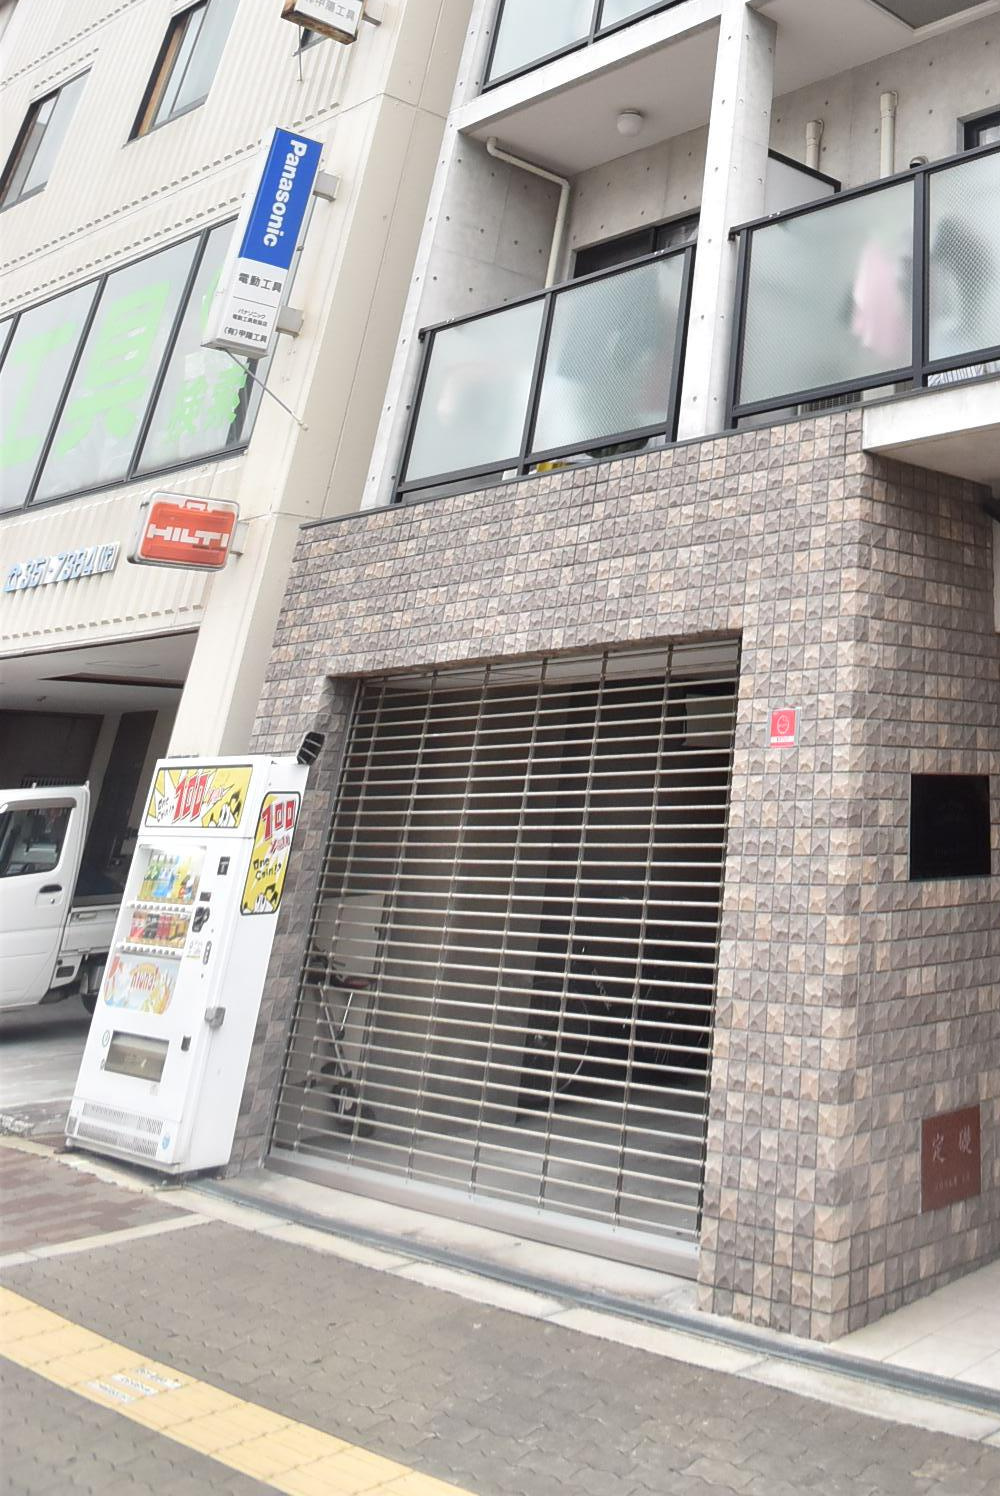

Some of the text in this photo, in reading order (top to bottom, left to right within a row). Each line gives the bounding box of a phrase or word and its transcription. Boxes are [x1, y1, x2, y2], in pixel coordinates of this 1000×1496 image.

[263, 139, 308, 248] Panasonic
[238, 272, 283, 294] 電動工具
[146, 523, 229, 549] HILTI
[172, 773, 209, 824] 100
[261, 799, 297, 842] 100
